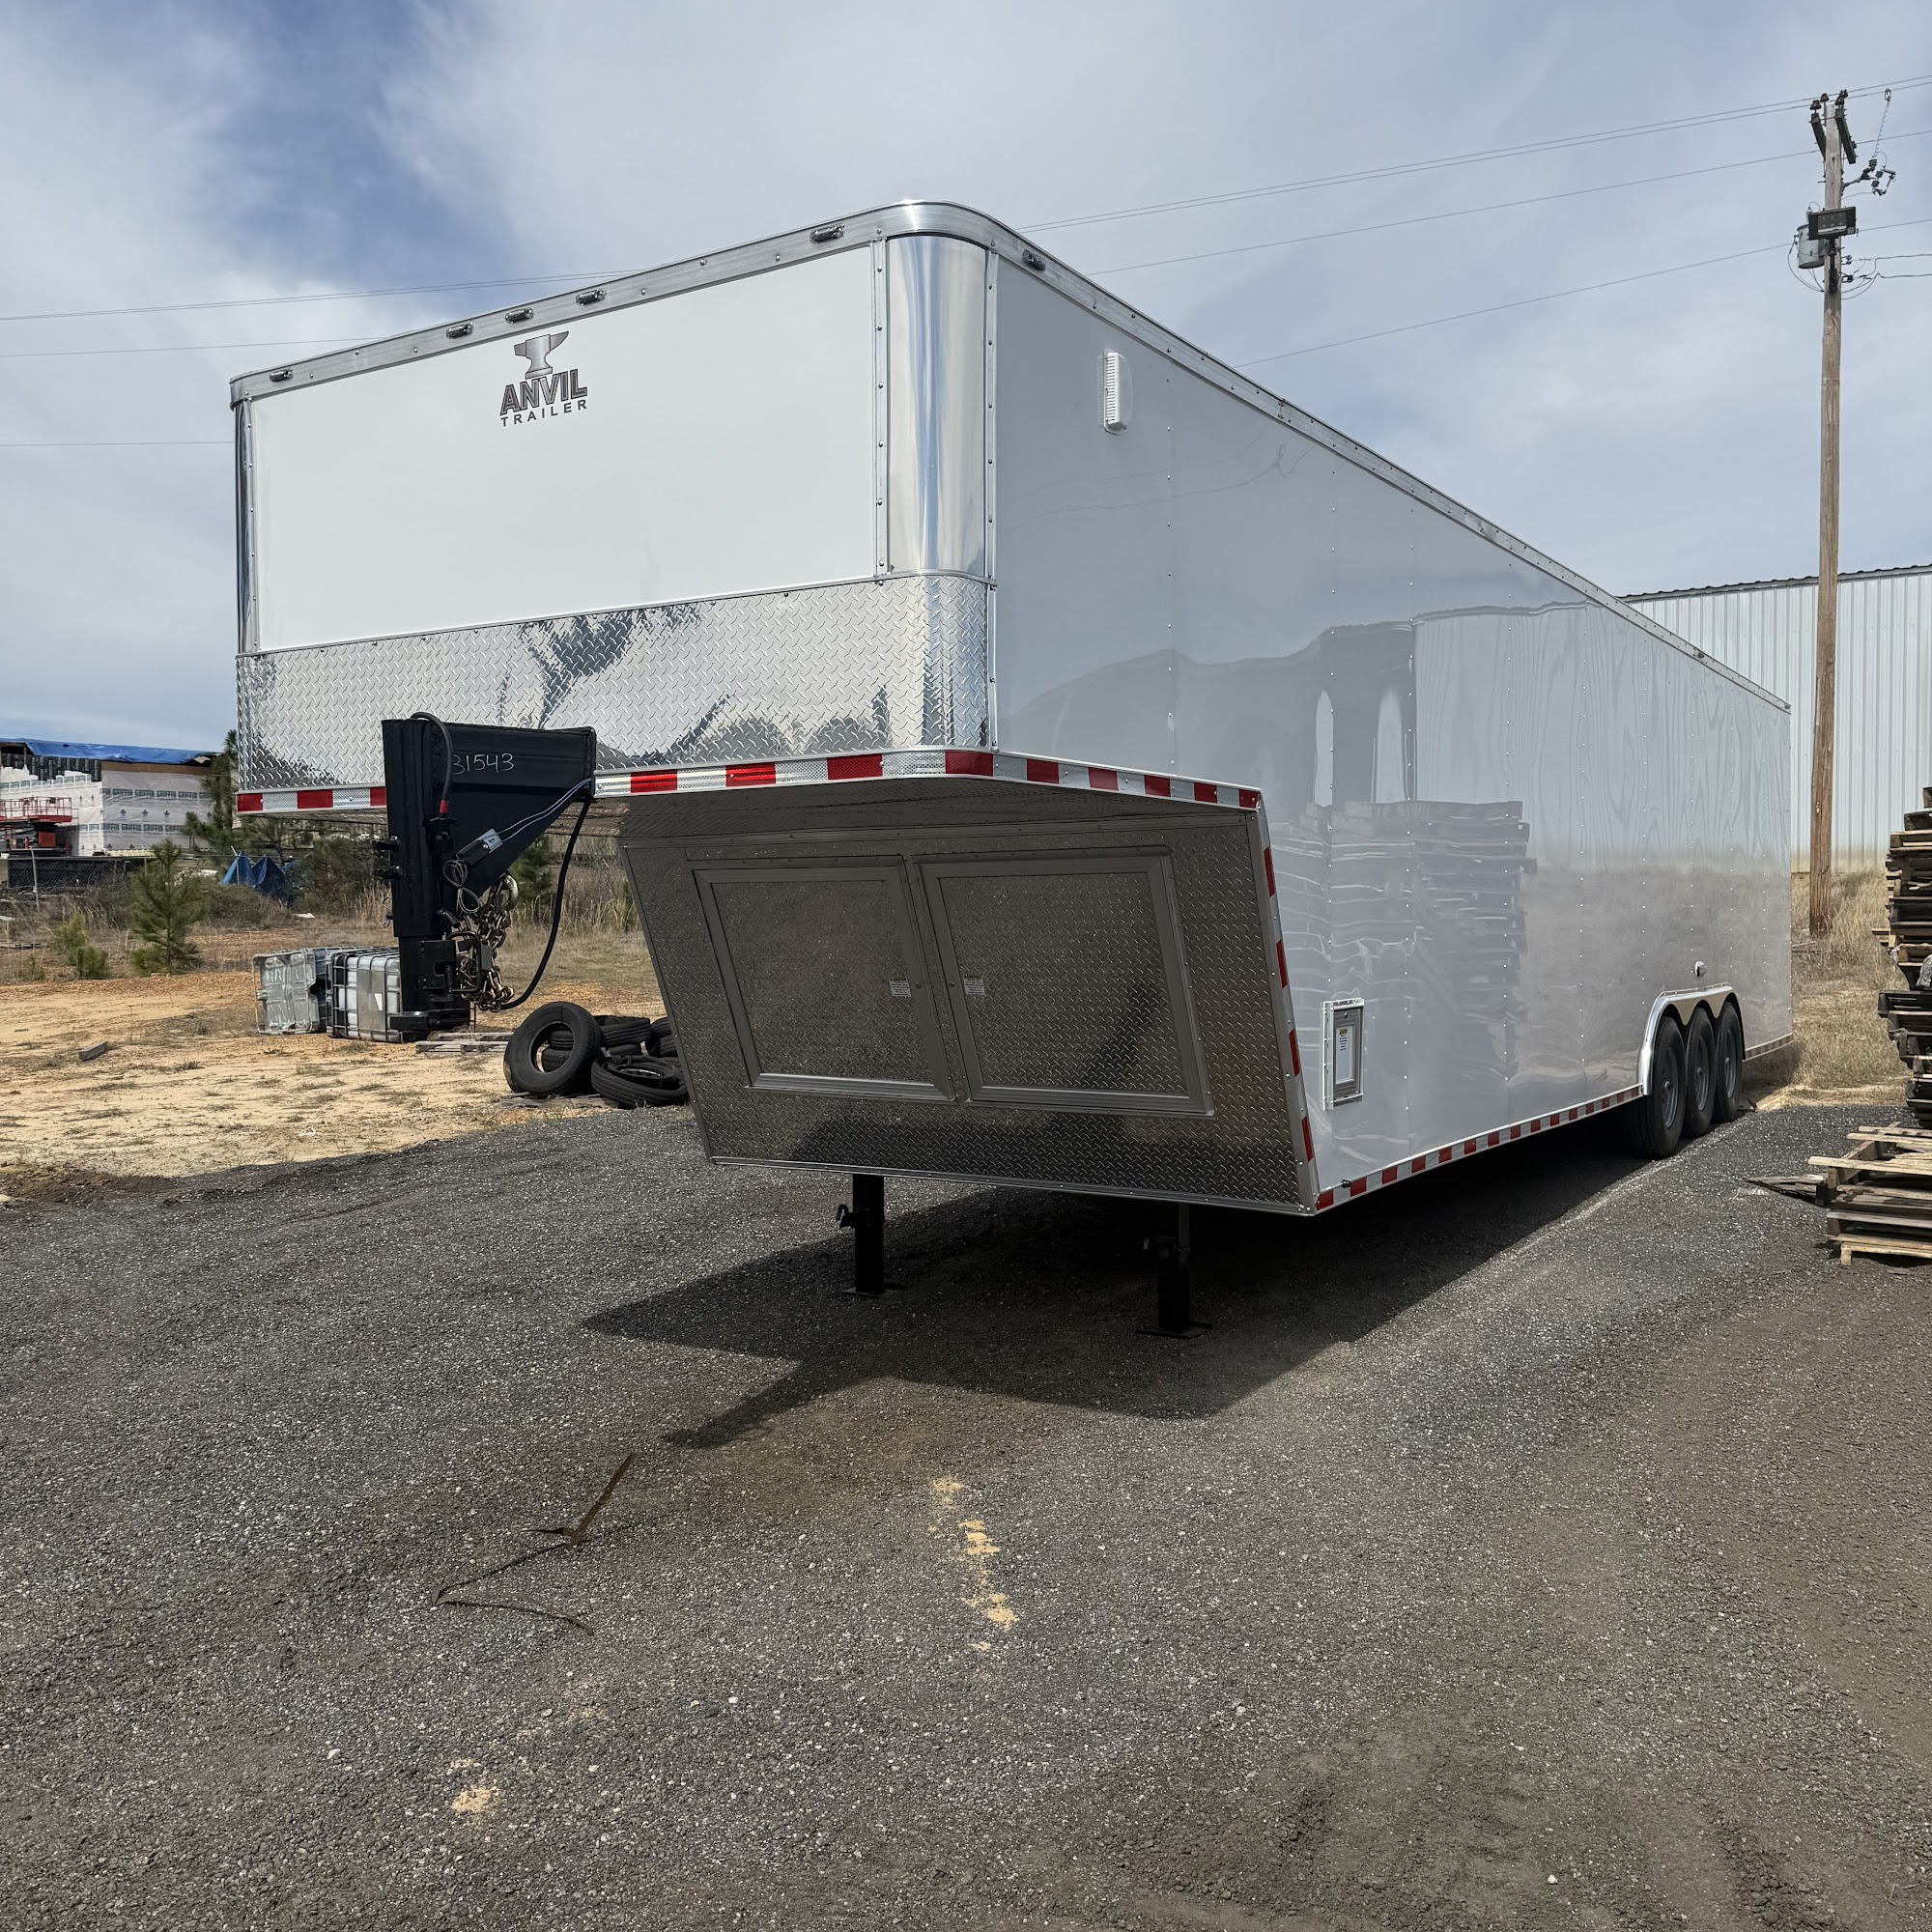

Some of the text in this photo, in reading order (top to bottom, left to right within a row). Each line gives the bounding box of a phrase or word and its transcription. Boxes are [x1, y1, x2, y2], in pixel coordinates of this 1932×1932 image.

[499, 368, 588, 416] ANVIL
[500, 399, 587, 427] TRAILER
[452, 753, 515, 775] 31543
